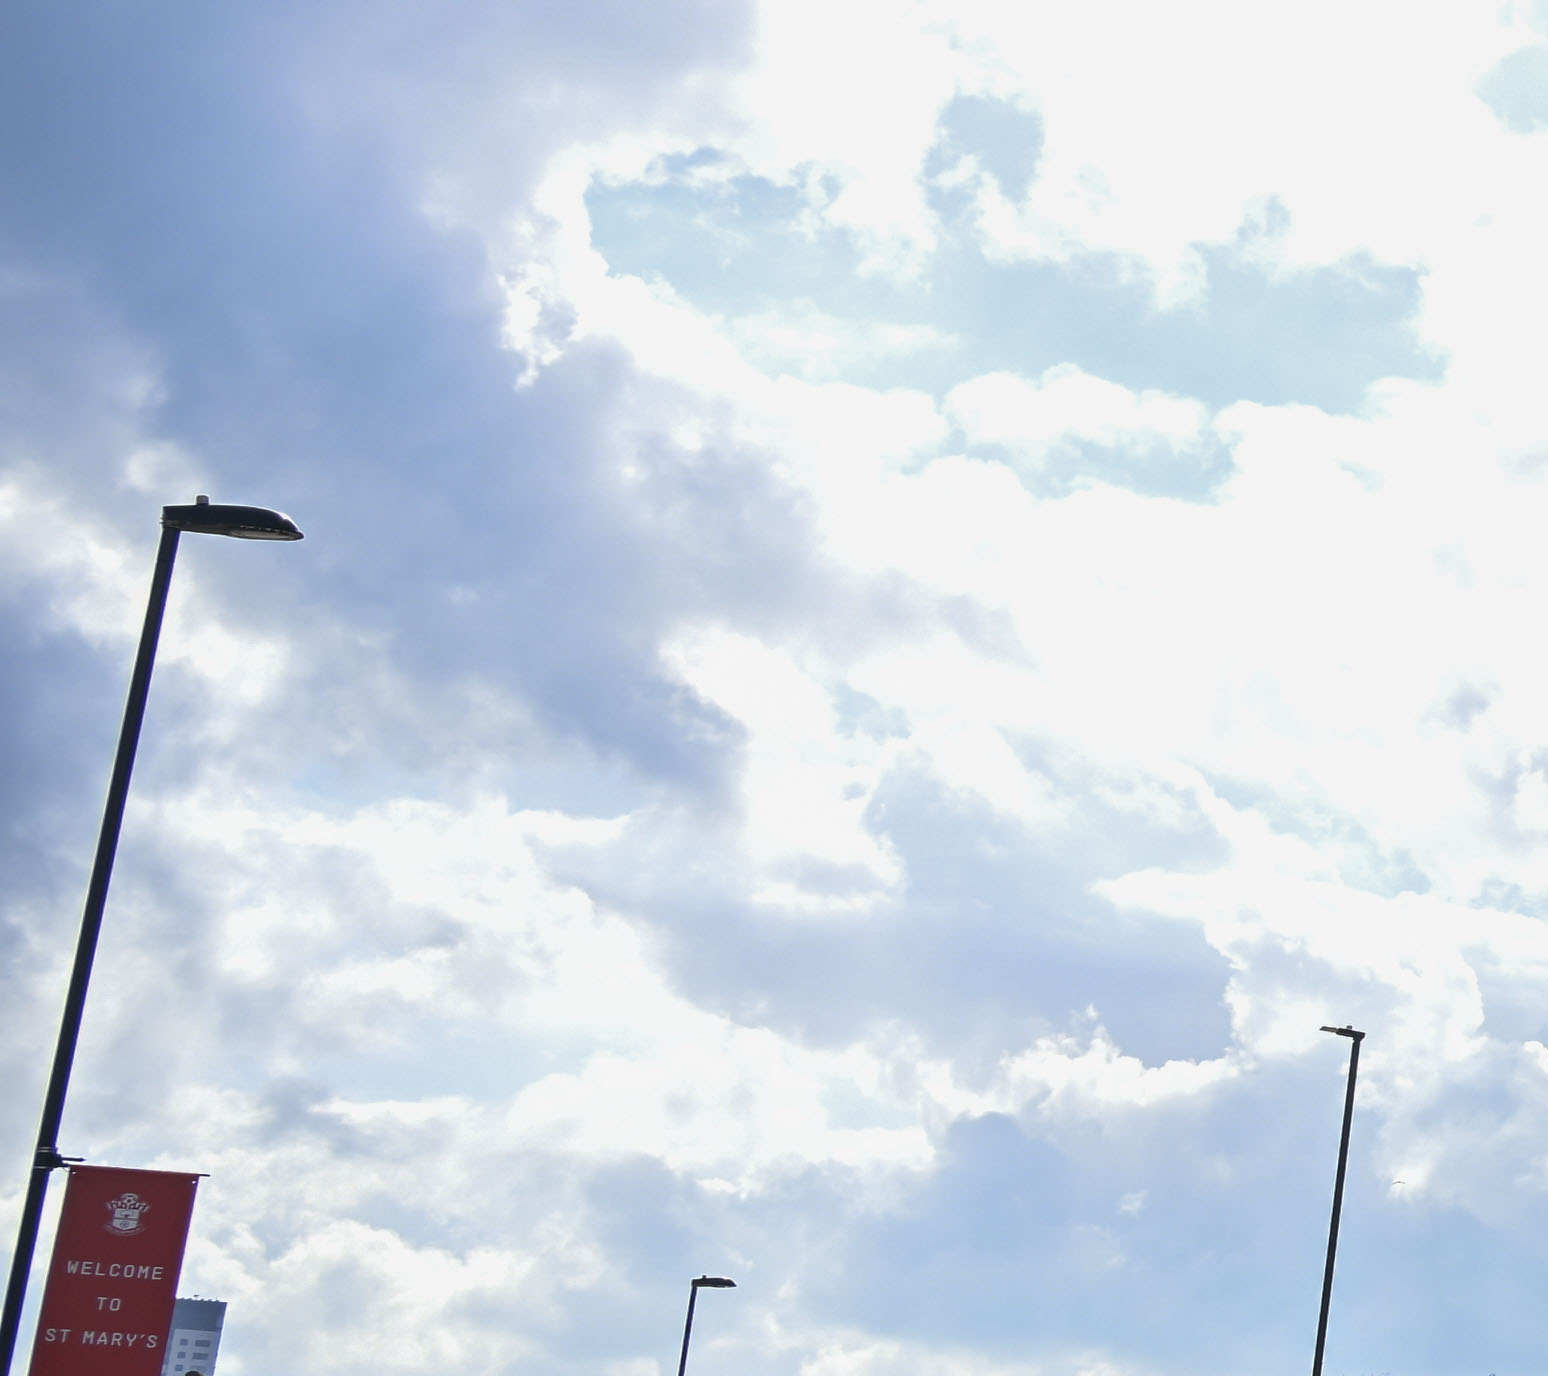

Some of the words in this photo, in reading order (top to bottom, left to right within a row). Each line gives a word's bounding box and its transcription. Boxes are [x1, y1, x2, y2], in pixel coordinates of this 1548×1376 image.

[66, 1260, 165, 1281] WELCOME
[96, 1296, 122, 1312] TO
[44, 1328, 72, 1343] ST
[81, 1330, 159, 1349] MARY'S
